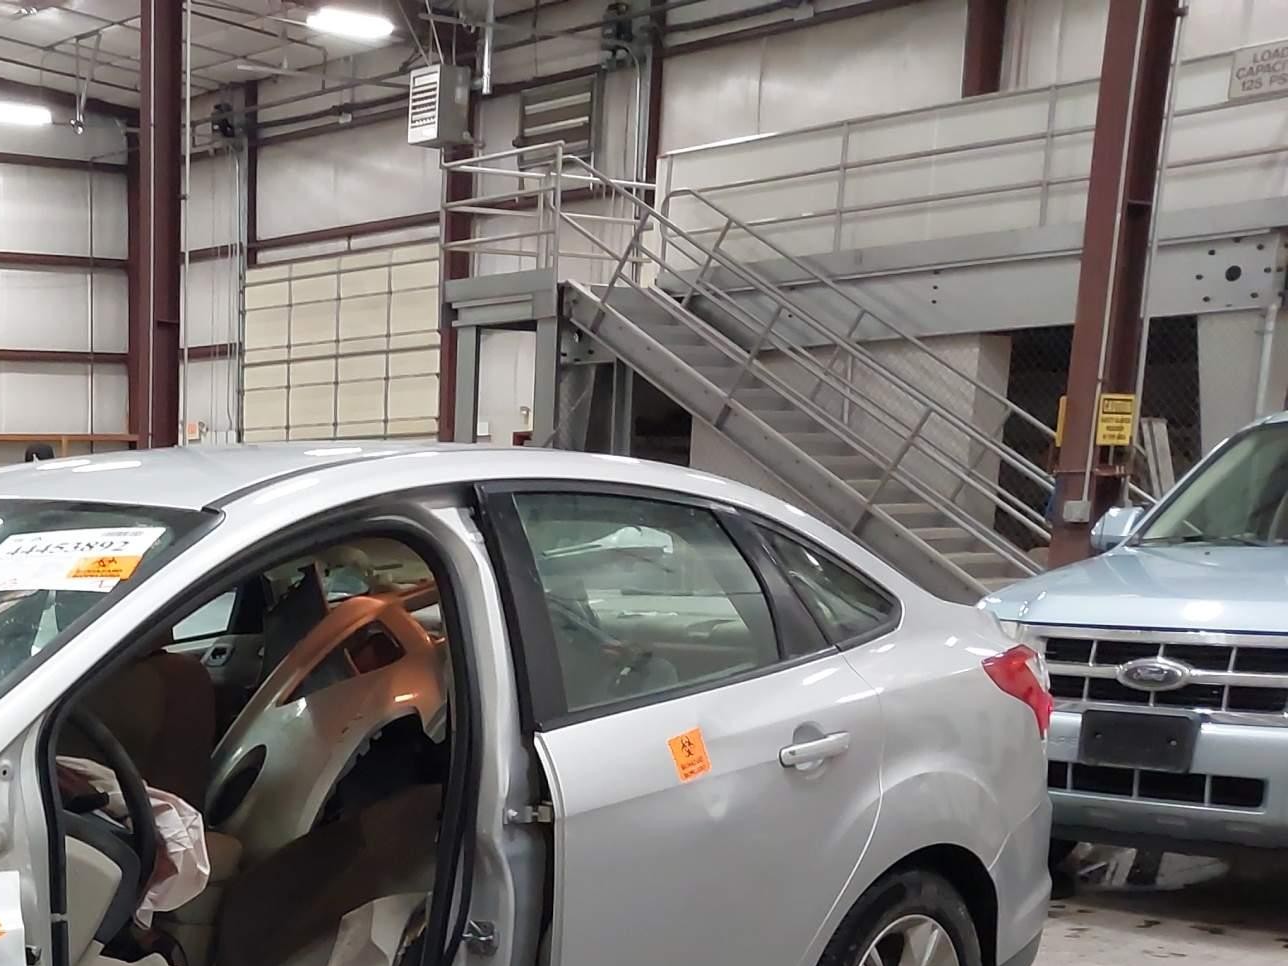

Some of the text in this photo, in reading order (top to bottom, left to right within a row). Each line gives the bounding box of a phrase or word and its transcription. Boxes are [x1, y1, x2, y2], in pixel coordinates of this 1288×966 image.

[1236, 59, 1288, 80] CAPACI
[1242, 73, 1288, 91] 125 PS
[5, 541, 131, 556] 44453892
